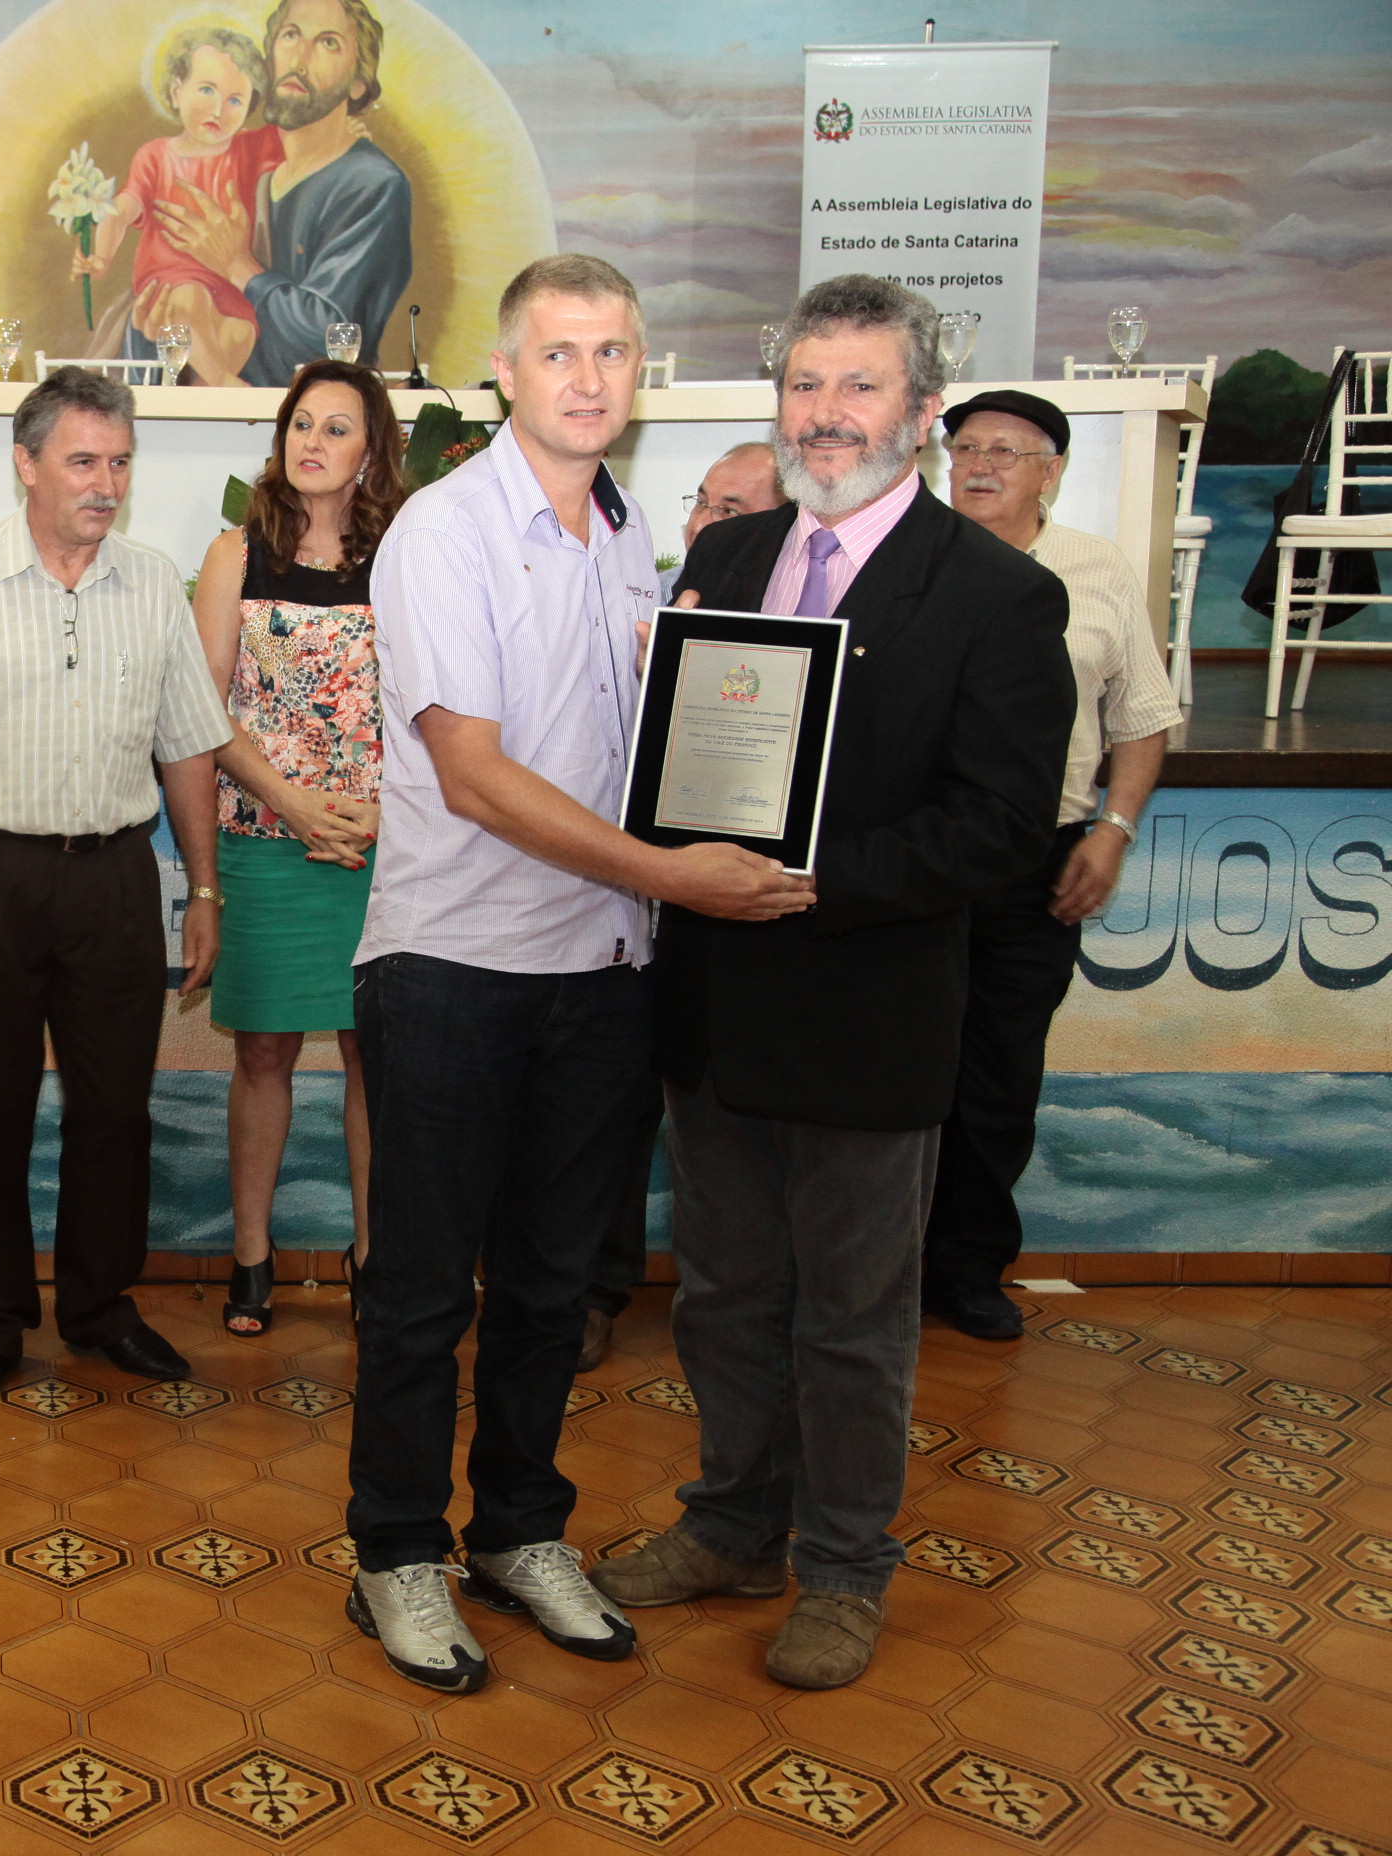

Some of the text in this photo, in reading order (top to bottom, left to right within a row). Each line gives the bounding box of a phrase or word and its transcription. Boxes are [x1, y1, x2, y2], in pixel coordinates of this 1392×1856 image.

[862, 106, 1032, 119] ASSEMBLEIA LEGISLATIVA
[860, 123, 1032, 136] DO ESTADO DE SANTA CATARINA
[811, 197, 1032, 213] A Assembleia Legislativa do
[822, 235, 1018, 249] Estado de Santa Catarina
[907, 276, 934, 285] nos
[940, 273, 1003, 288] projetos
